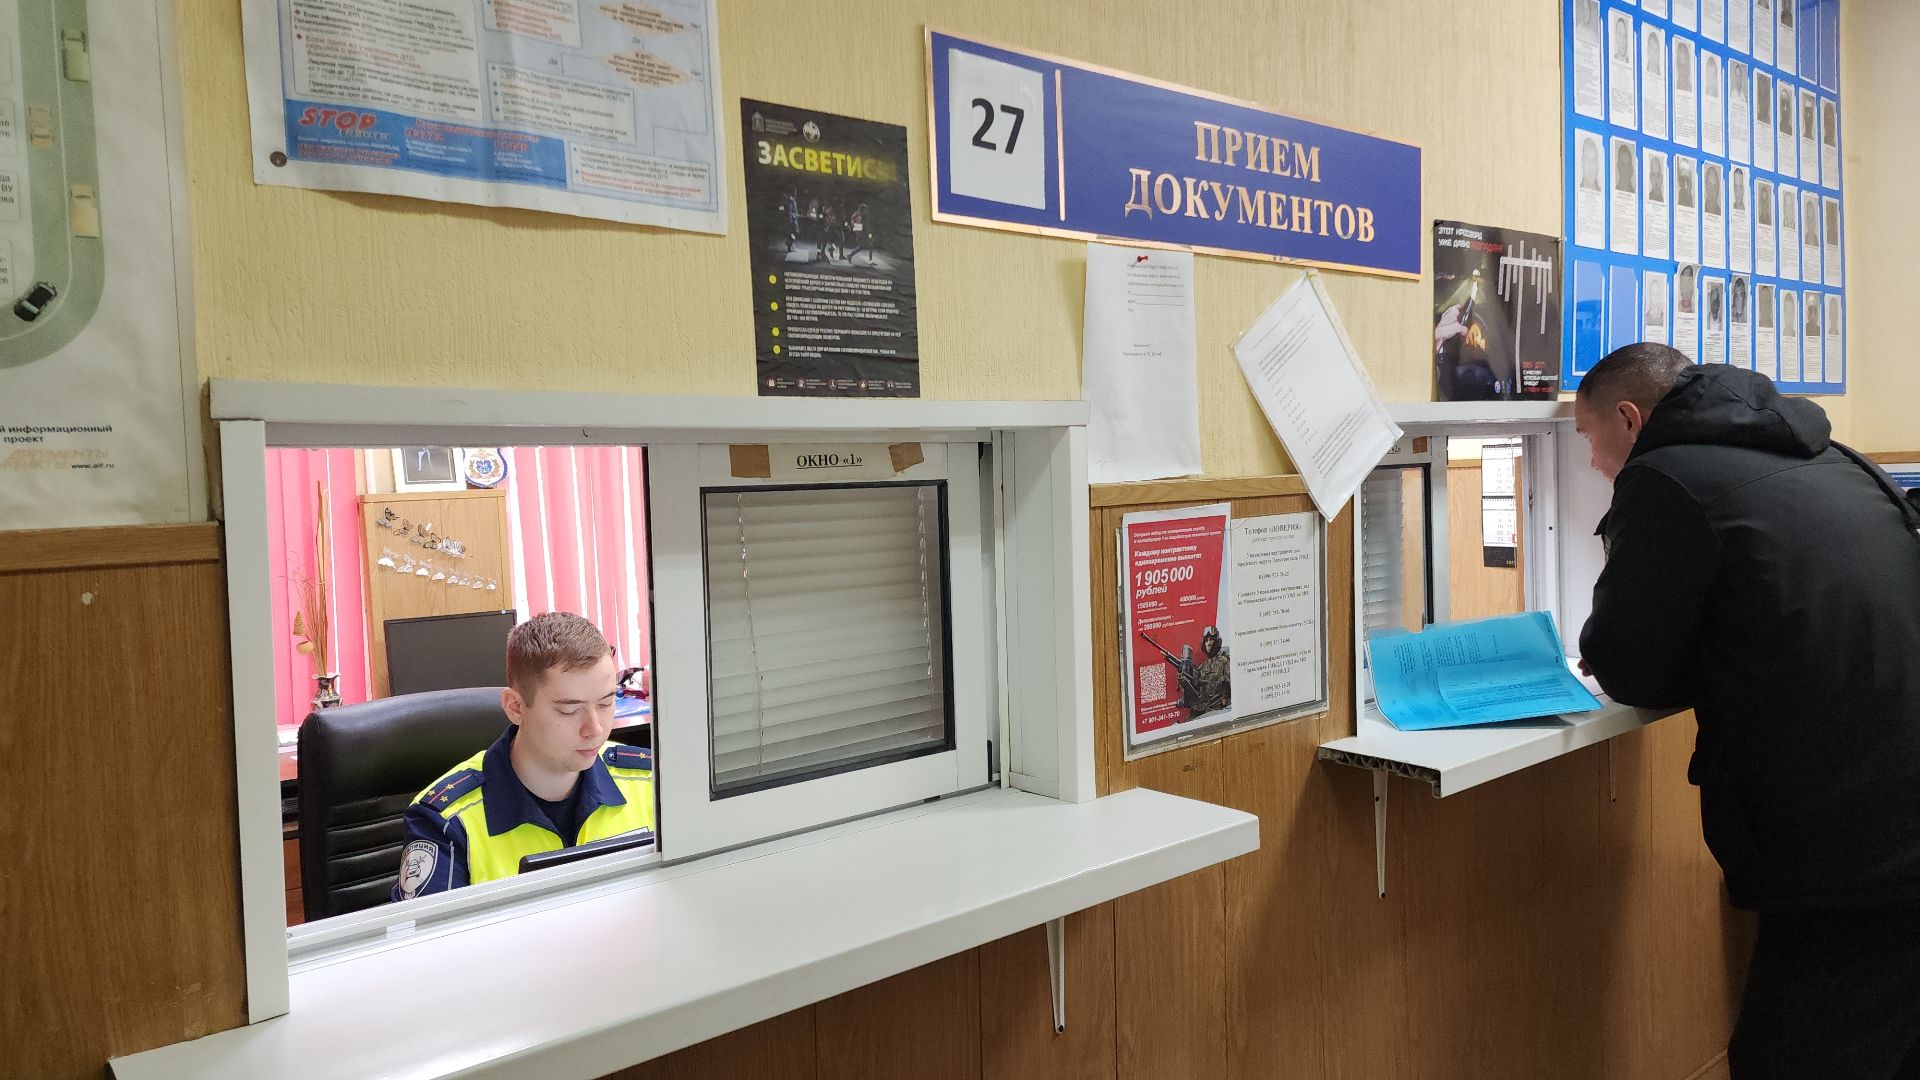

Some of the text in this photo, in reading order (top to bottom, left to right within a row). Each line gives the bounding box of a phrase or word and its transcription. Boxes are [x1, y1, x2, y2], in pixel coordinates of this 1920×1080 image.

[298, 107, 377, 130] STOP
[972, 98, 1025, 155] 27
[1195, 120, 1321, 183] ПРИЕМ
[1124, 167, 1375, 244] ДОКУМЕНТОВ
[8, 425, 112, 434] информационный
[4, 436, 44, 444] проект
[796, 454, 862, 467] ОКНО «1»
[1136, 584, 1168, 598] рублей
